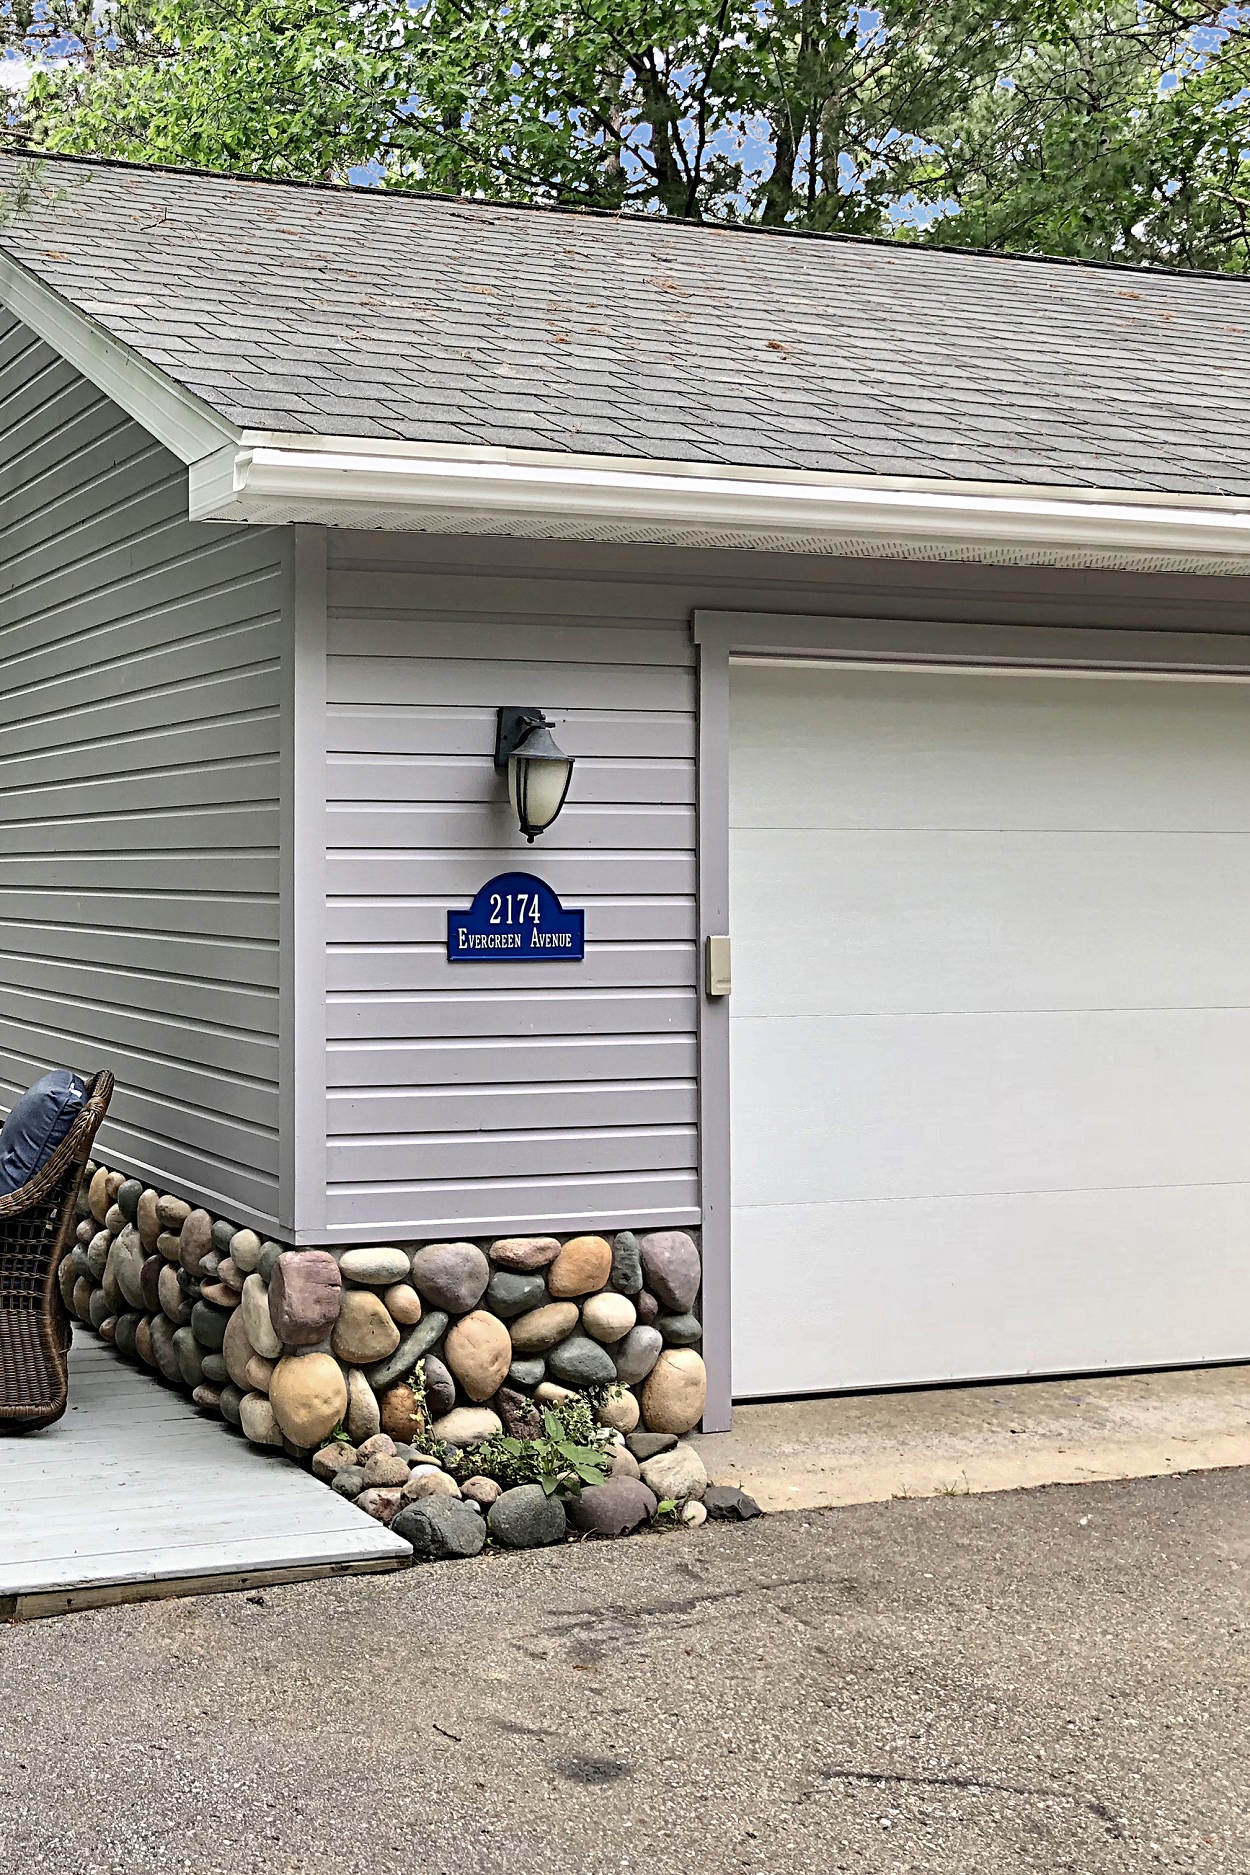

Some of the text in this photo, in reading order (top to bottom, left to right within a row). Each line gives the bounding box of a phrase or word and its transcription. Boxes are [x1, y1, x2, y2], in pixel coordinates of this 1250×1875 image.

[489, 893, 541, 924] 2174
[458, 926, 572, 949] EVERGREEN AVENUE
